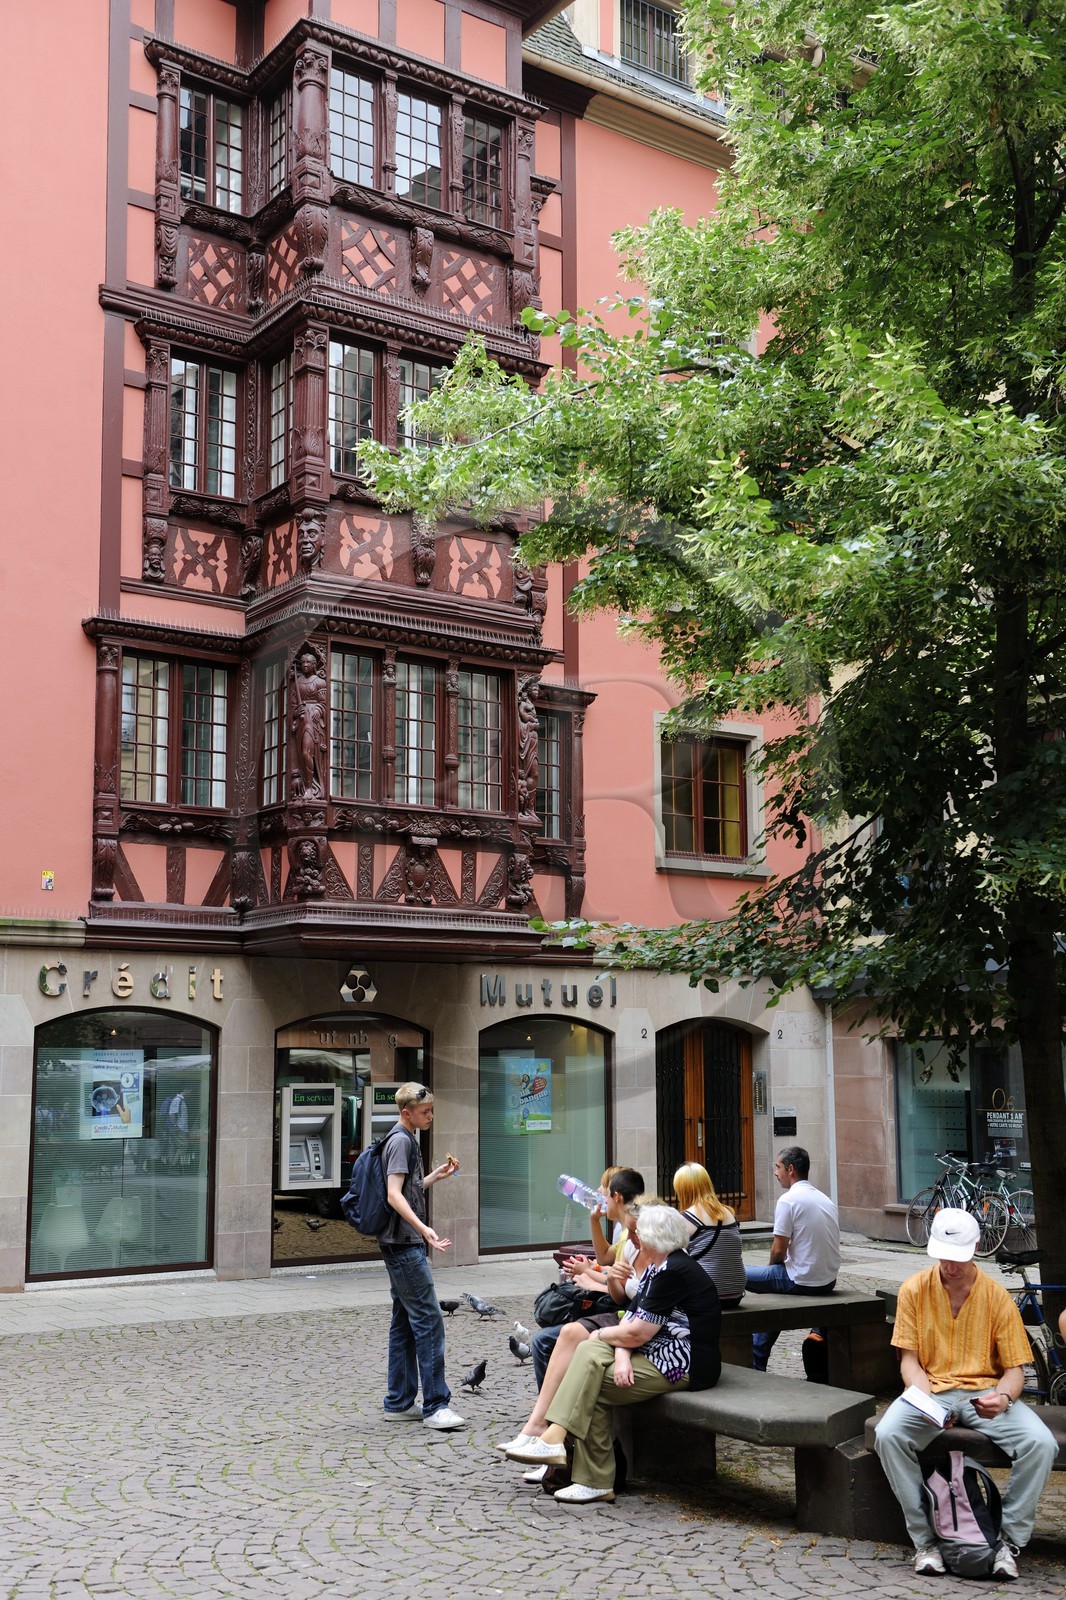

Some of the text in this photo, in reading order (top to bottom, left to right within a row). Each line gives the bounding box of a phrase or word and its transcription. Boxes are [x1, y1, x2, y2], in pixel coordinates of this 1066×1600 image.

[38, 961, 617, 1008] Crédit Mutuel
[641, 1028, 648, 1039] 2
[777, 1029, 784, 1040] 2
[294, 1093, 333, 1102] En service
[375, 1092, 386, 1101] En
